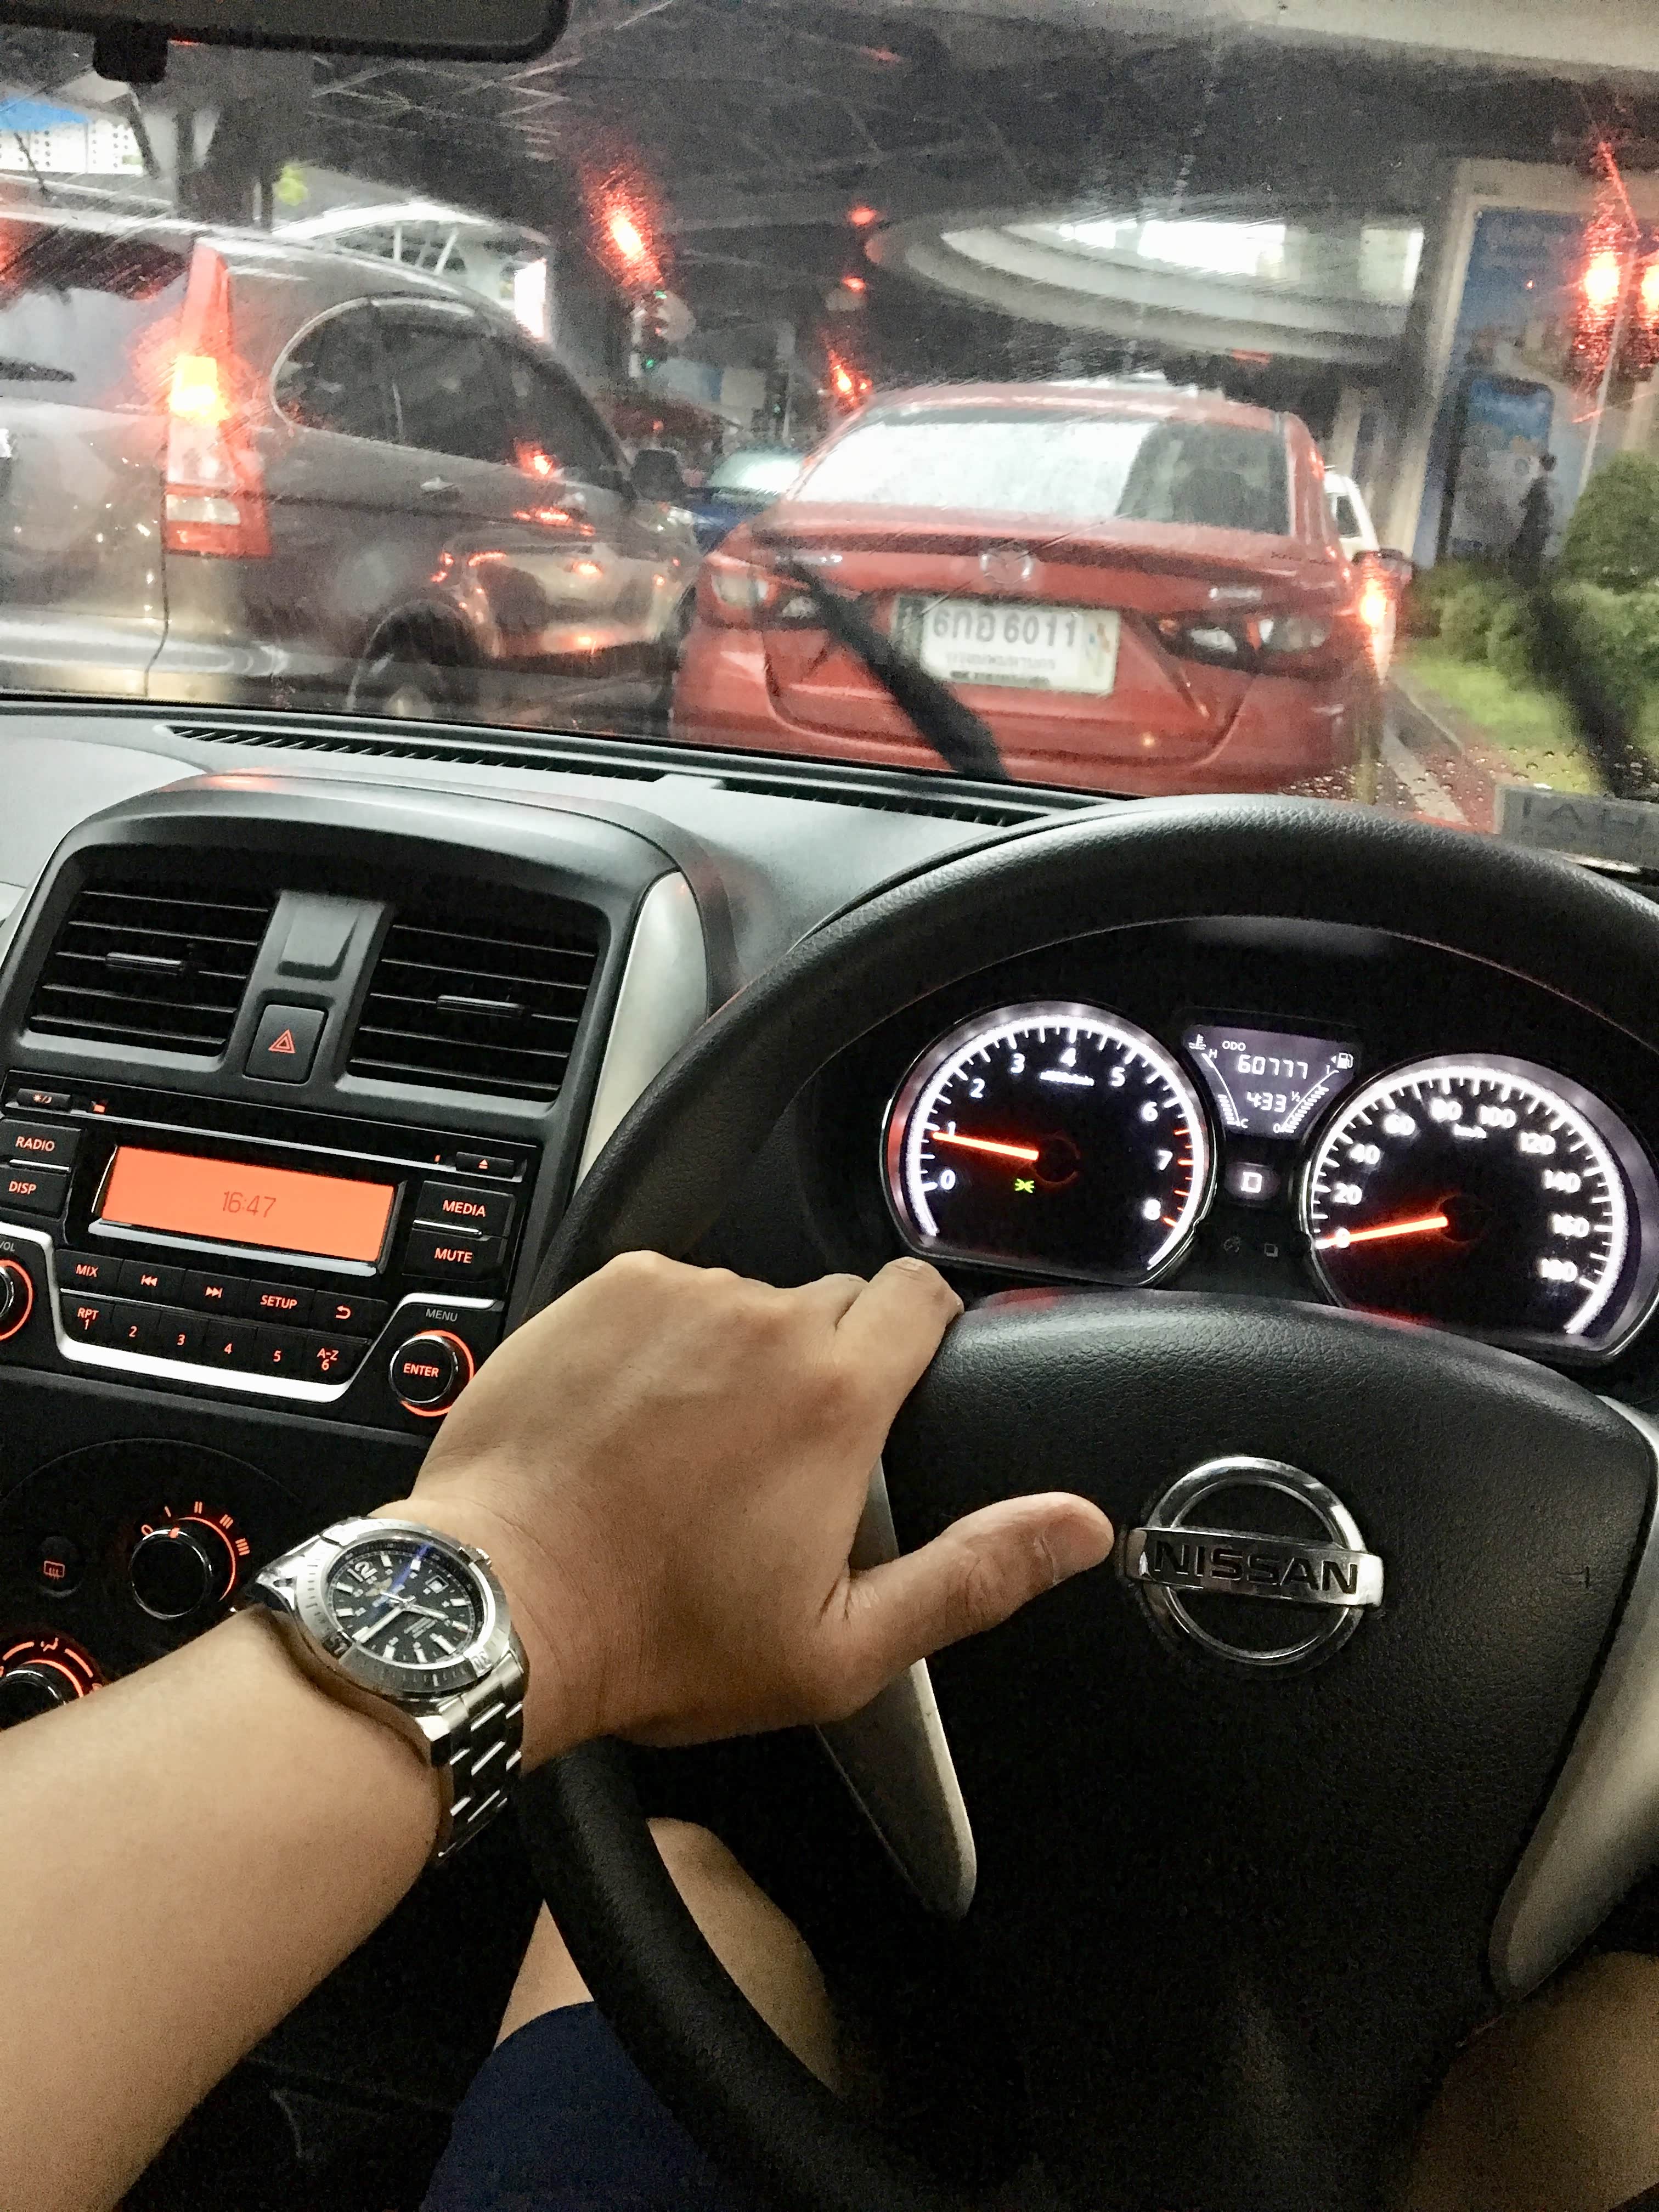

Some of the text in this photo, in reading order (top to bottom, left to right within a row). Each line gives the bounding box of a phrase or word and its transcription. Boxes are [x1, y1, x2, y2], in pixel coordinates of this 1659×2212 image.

[1003, 612, 1079, 647] 6011
[1209, 1048, 1218, 1059] H
[1222, 1040, 1246, 1051] ODO
[1011, 1053, 1026, 1074] 3
[1061, 1048, 1076, 1067] 4
[1238, 1054, 1308, 1080] 60777
[1110, 1067, 1125, 1087] 5
[970, 1079, 985, 1099] 2
[1247, 1091, 1286, 1113] 433
[1143, 1102, 1158, 1122] 6
[1480, 1105, 1516, 1128] 100
[1240, 1118, 1249, 1128] C
[15, 1136, 55, 1152] RADIO
[1521, 1132, 1556, 1155] 120
[1159, 1150, 1173, 1170] 7
[8, 1181, 37, 1195] DISP
[941, 1170, 956, 1190] 0
[1333, 1183, 1363, 1206] 20
[223, 1191, 276, 1217] 16:47
[443, 1199, 486, 1217] MEDIA
[434, 1248, 473, 1264] MUTE
[75, 1264, 99, 1278] MIX
[260, 1295, 297, 1309] SETUP
[77, 1307, 99, 1320] RPT
[425, 1308, 458, 1322] MENU
[84, 1319, 90, 1330] 1
[128, 1325, 138, 1338] 2
[177, 1334, 186, 1346] 3
[223, 1343, 233, 1355] 4
[273, 1350, 281, 1362] 5
[317, 1347, 340, 1361] A-Z
[321, 1359, 330, 1371] 6
[403, 1363, 439, 1378] ENTER
[347, 1561, 377, 1582] 12
[1154, 1539, 1358, 1595] NISSAN
